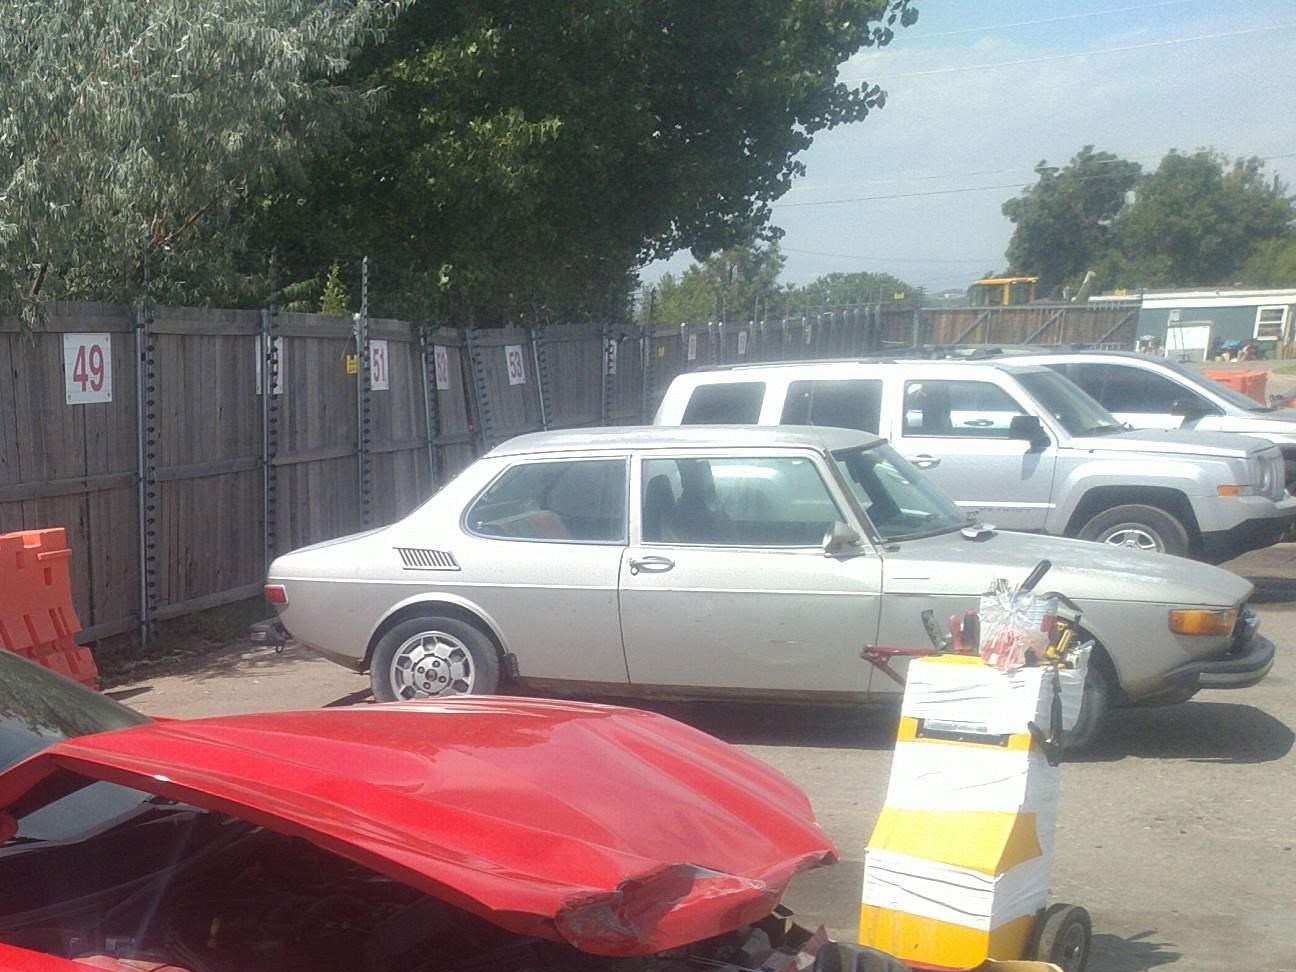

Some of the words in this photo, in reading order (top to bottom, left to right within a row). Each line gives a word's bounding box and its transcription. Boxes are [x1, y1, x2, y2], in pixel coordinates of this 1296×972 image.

[73, 344, 104, 393] 49
[373, 348, 386, 382] 51
[436, 351, 448, 383] 52
[509, 351, 523, 379] 53
